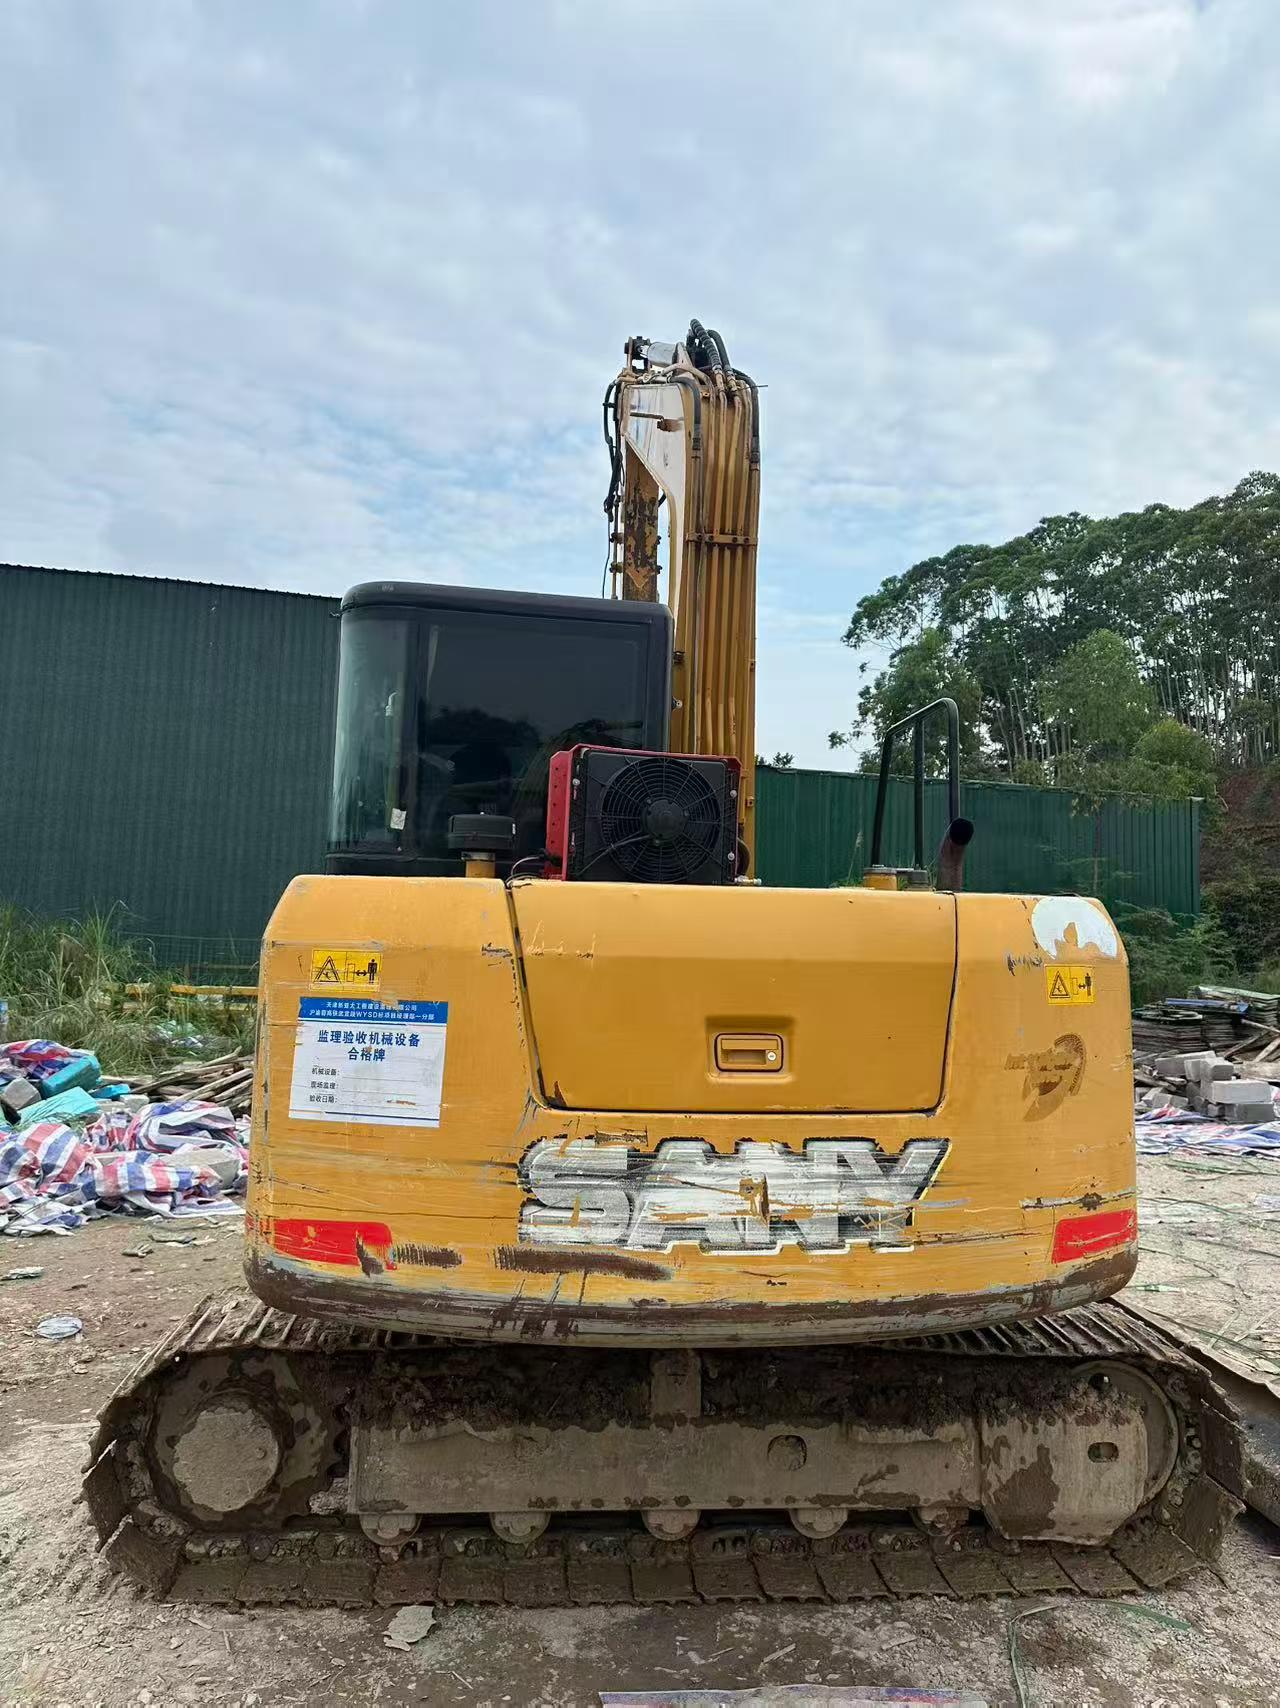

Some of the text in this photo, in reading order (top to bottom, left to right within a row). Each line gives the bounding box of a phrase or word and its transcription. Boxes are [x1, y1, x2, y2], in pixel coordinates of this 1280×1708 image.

[317, 1029, 421, 1048] 监理验收机械设备
[347, 1046, 386, 1062] 合格牌
[517, 1135, 950, 1254] SANY
